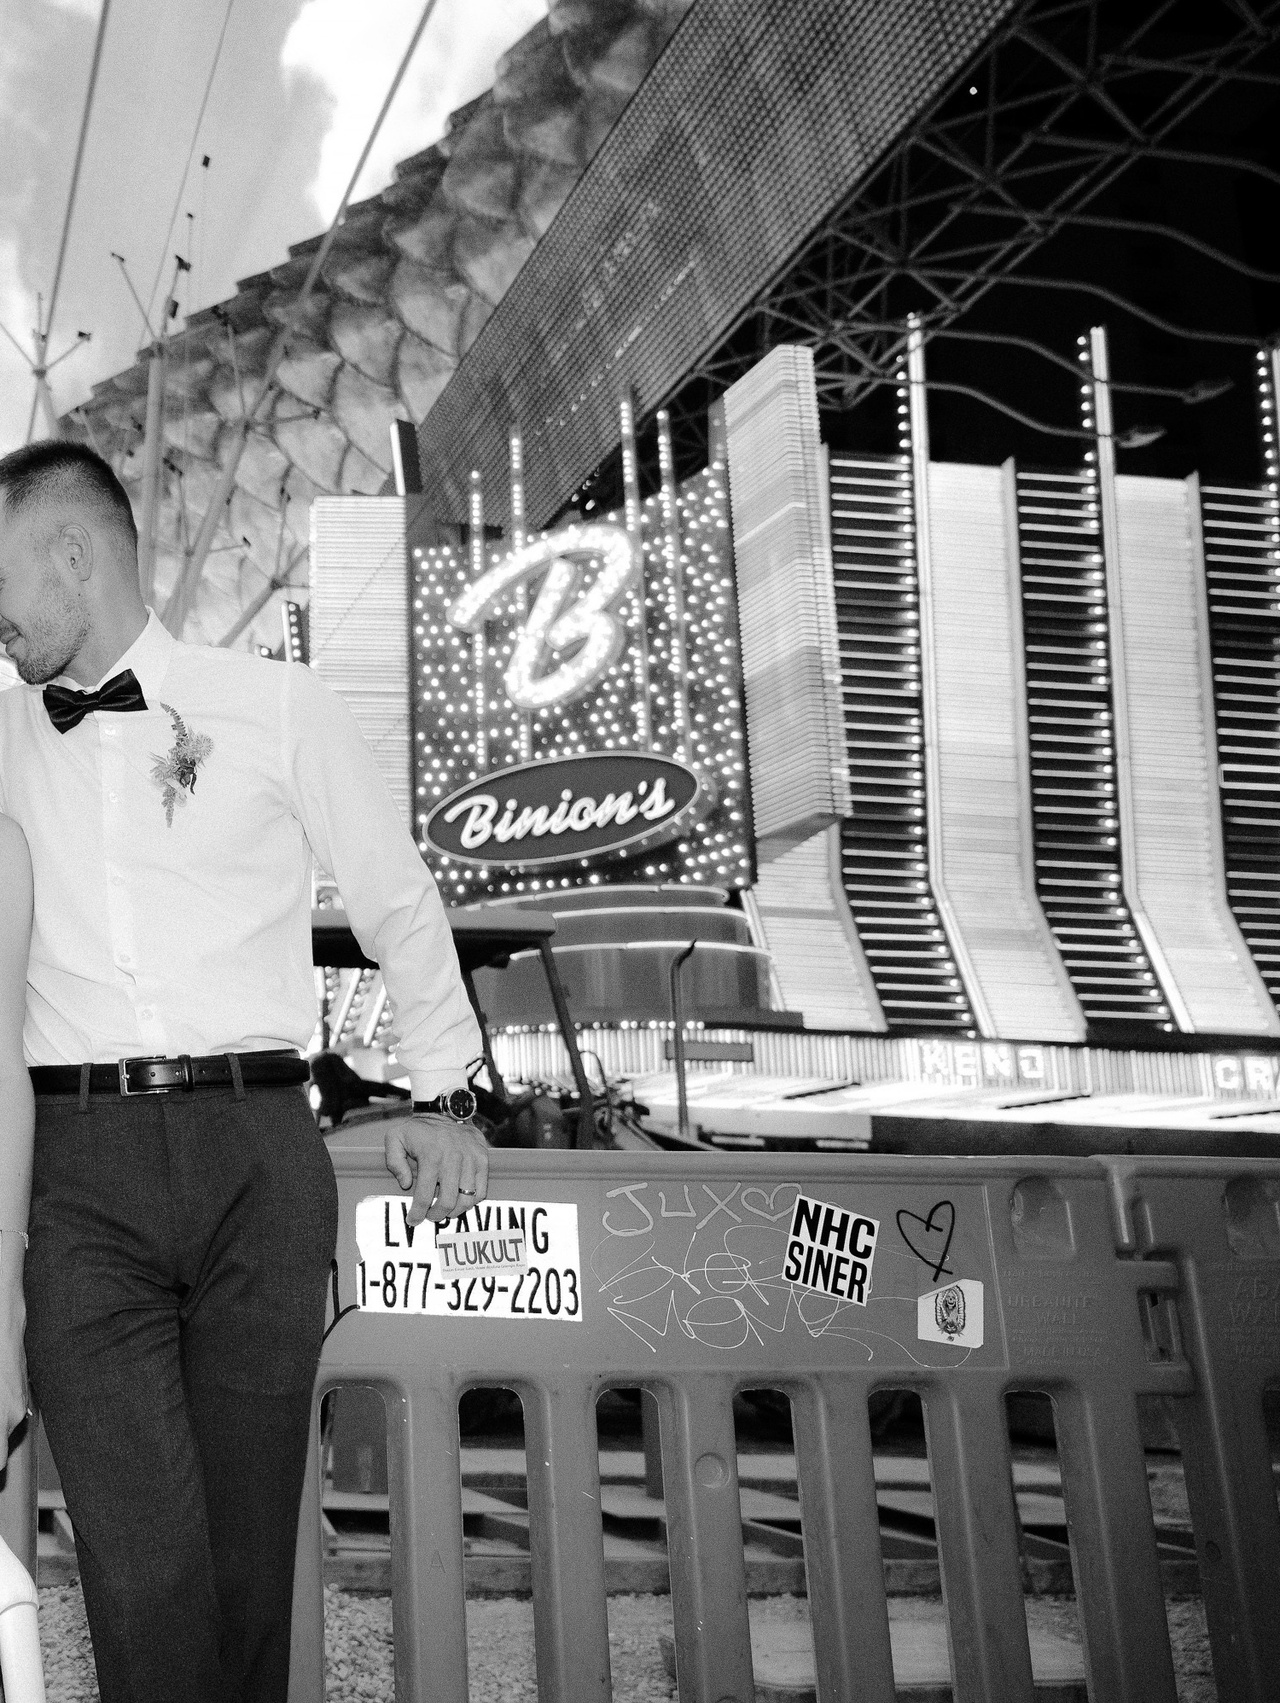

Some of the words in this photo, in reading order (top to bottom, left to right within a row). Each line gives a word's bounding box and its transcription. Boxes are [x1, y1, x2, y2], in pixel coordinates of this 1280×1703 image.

[447, 524, 634, 707] B
[444, 777, 676, 849] Binion's
[922, 1043, 1044, 1080] KENO
[1214, 1056, 1280, 1091] CR
[384, 1201, 417, 1248] LV
[793, 1198, 876, 1260] NHC
[359, 1260, 579, 1316] 1-877-329-2203
[784, 1239, 868, 1305] SINER
